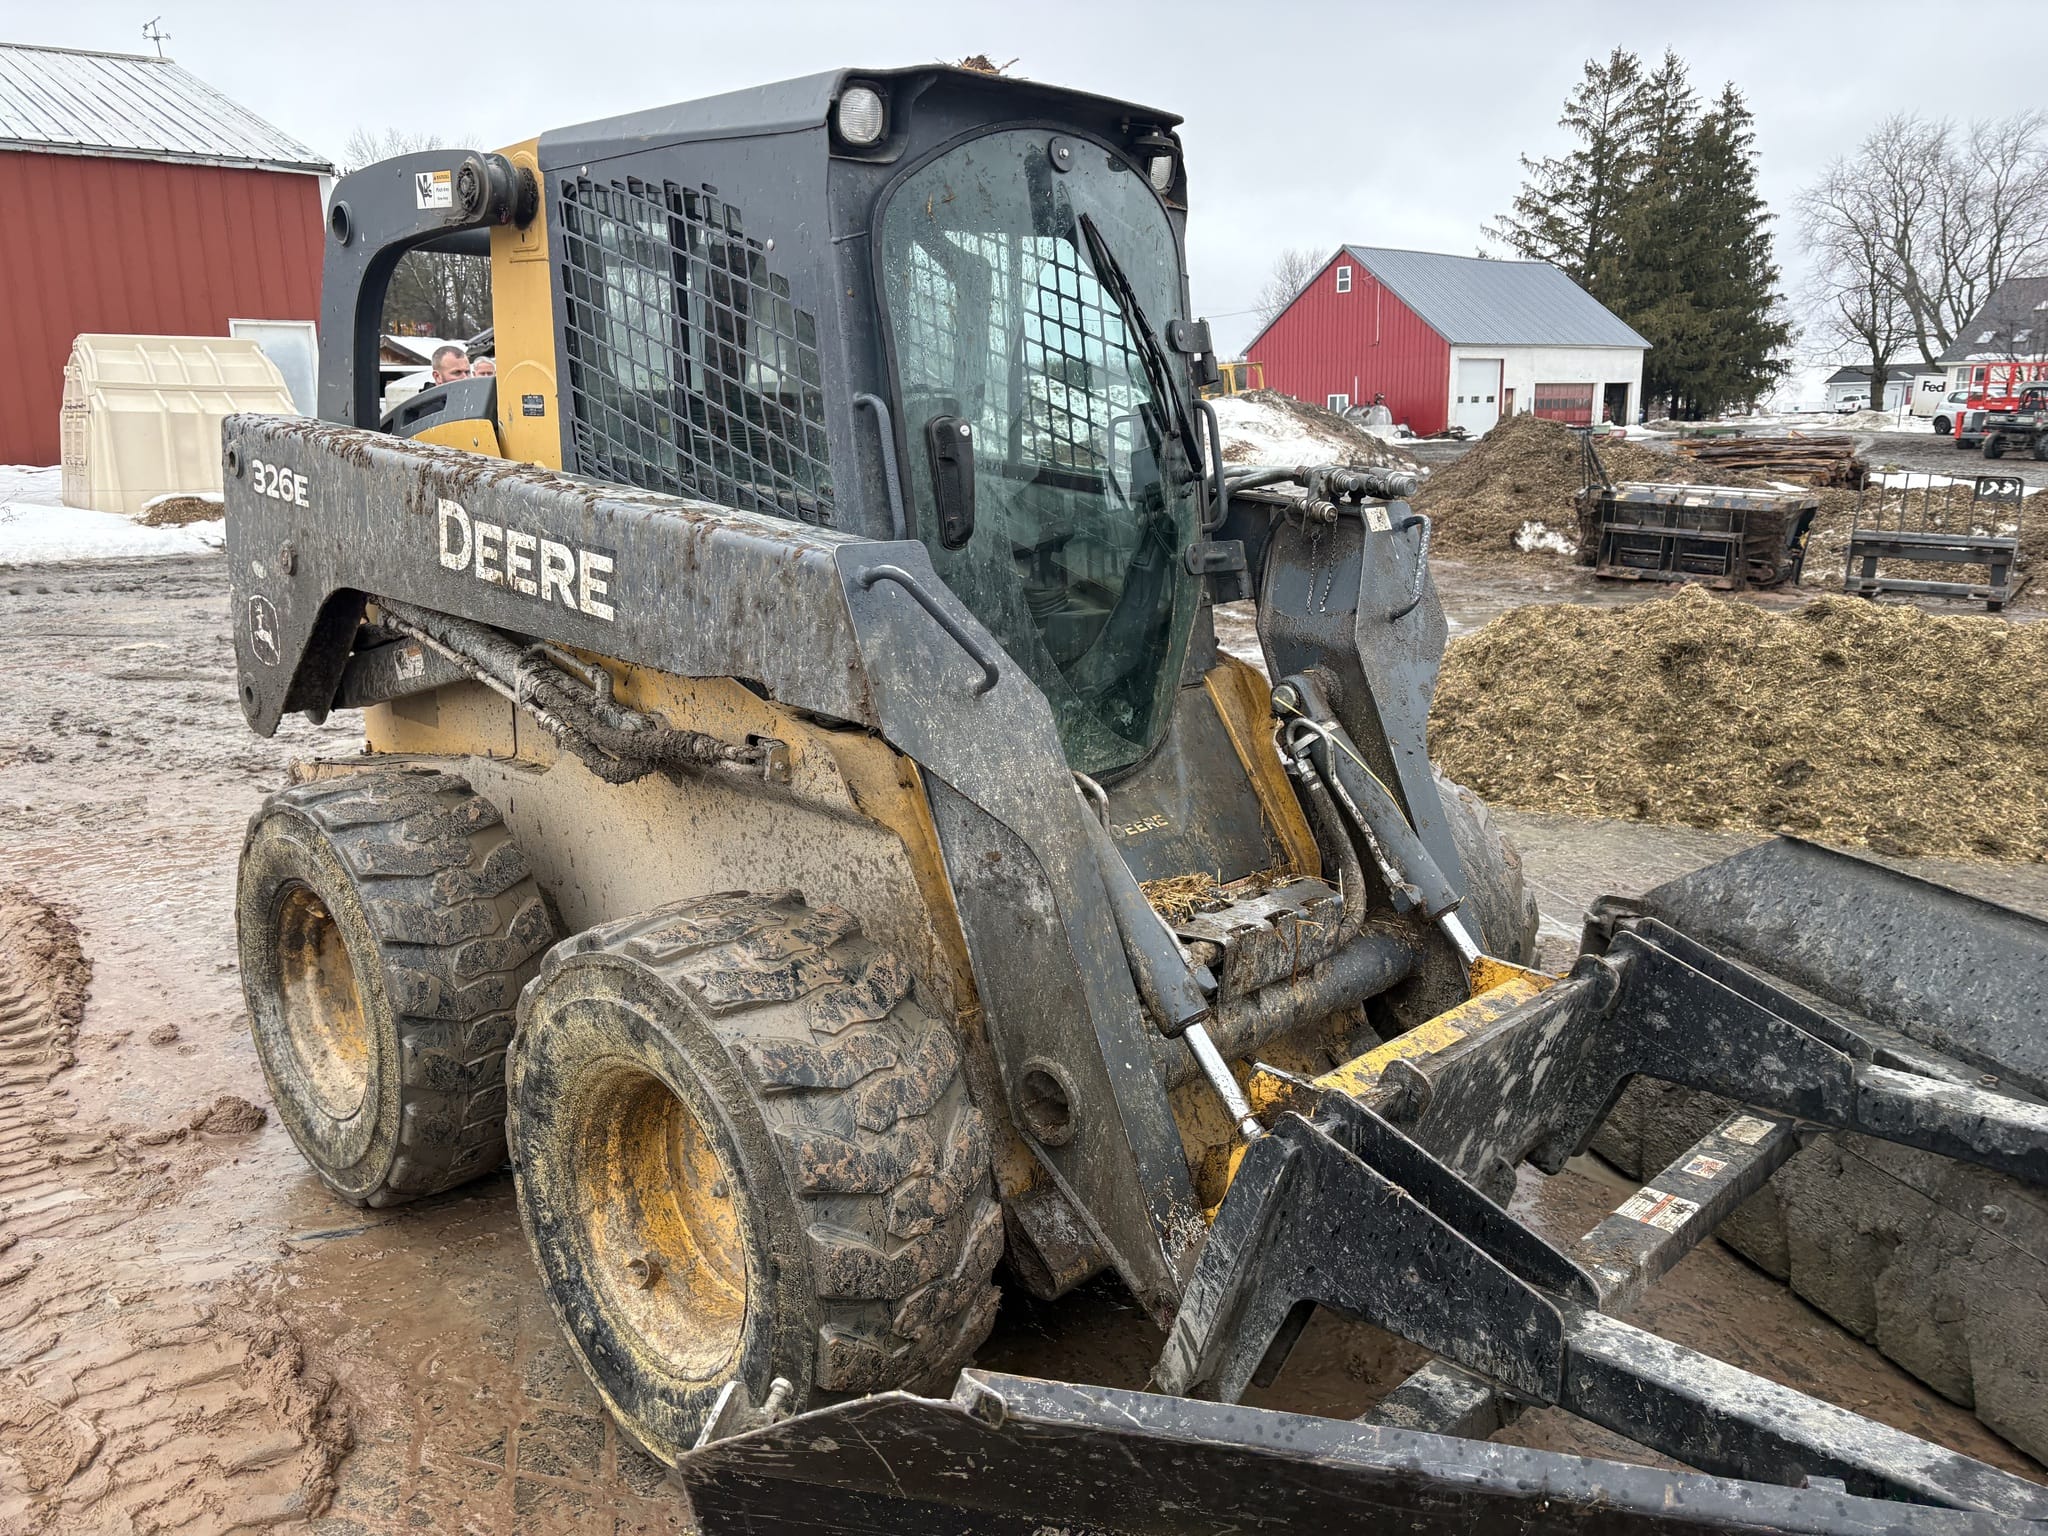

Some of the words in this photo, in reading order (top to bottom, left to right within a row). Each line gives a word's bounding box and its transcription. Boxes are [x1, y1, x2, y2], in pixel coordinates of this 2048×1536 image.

[1922, 380, 1946, 392] Fed
[252, 459, 310, 508] 326E
[438, 498, 614, 622] DEERE
